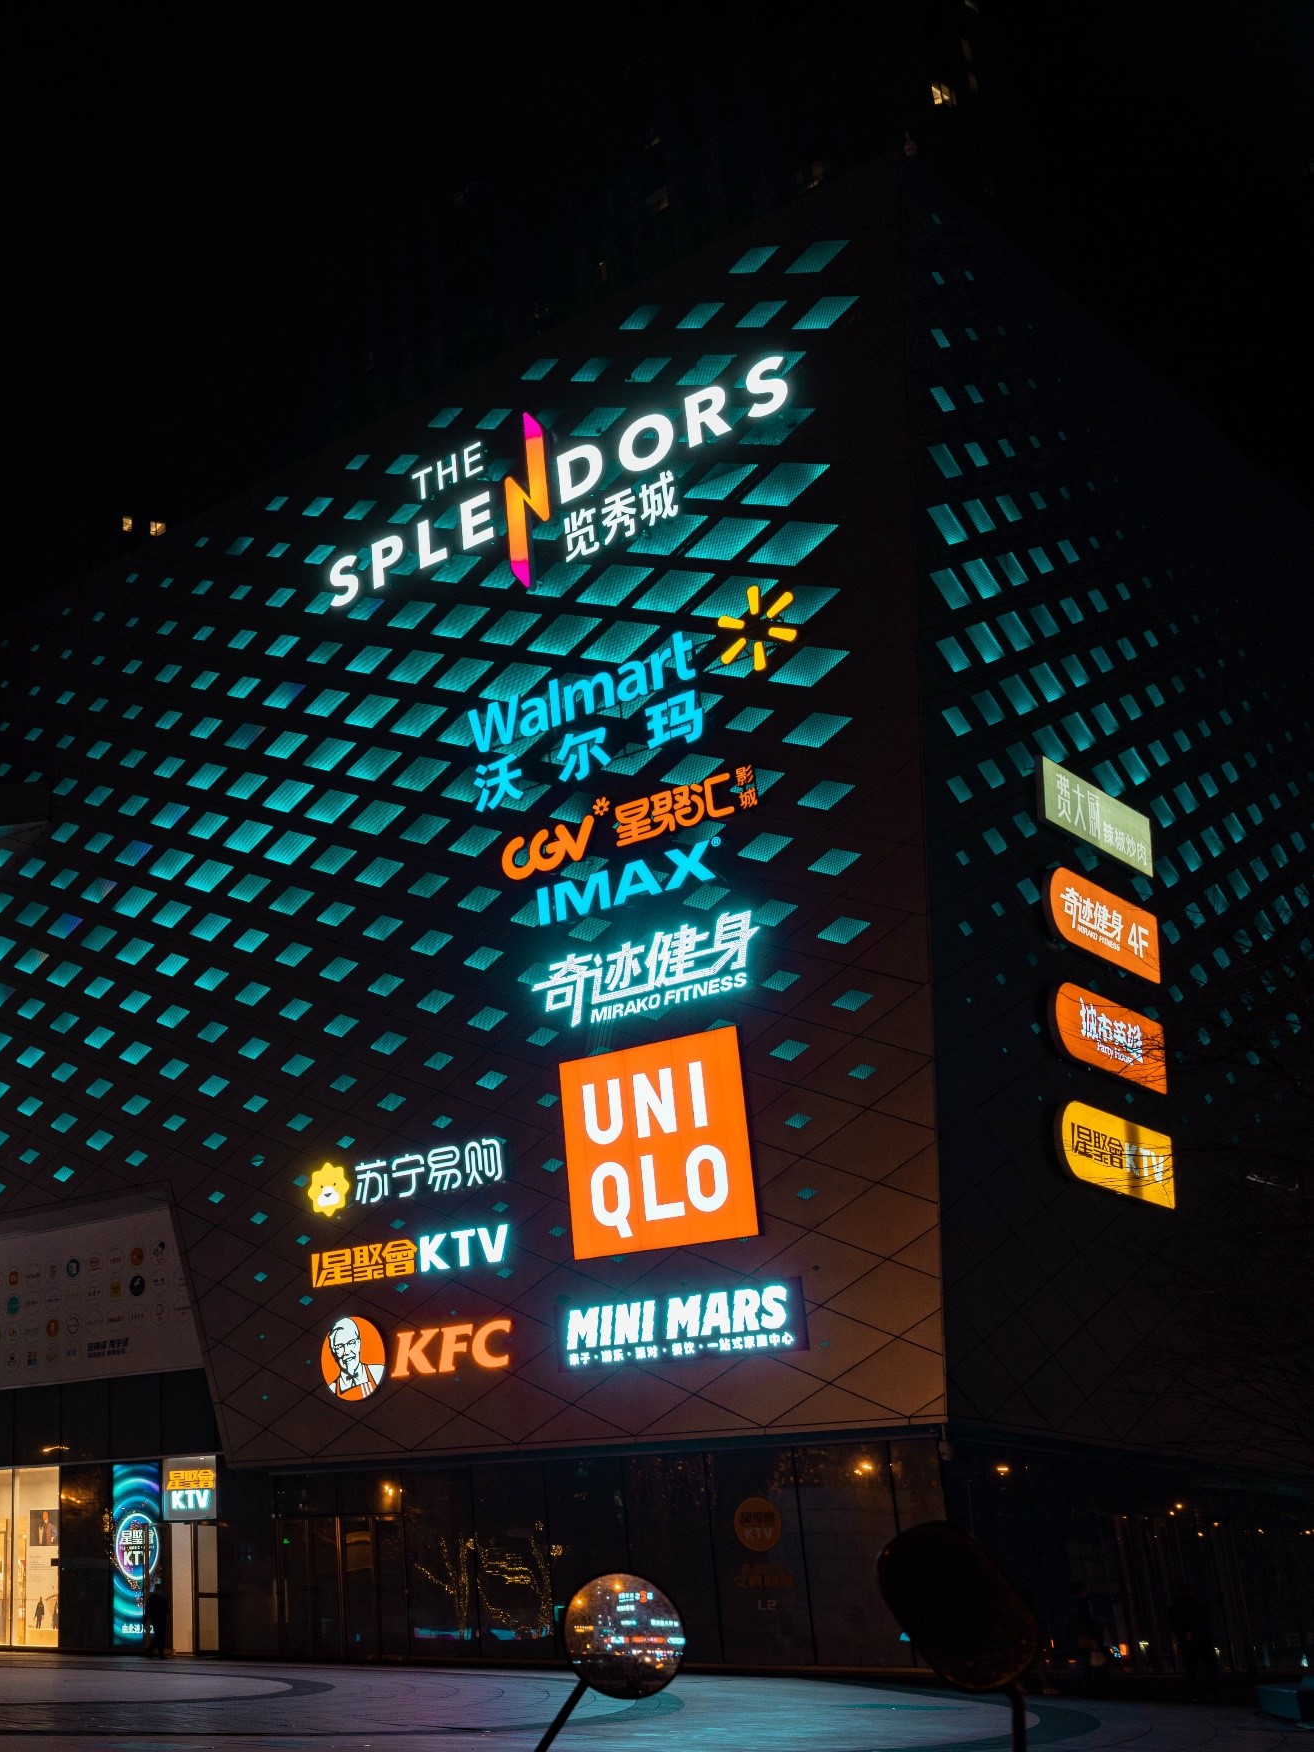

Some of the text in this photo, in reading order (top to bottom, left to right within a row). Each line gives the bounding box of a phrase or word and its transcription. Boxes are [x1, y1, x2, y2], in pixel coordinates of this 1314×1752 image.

[329, 356, 788, 607] SPLENDORS
[412, 441, 484, 499] THE
[564, 470, 679, 562] 览秀城
[467, 632, 697, 753] Walmart
[474, 690, 704, 813] 沃尔玛
[735, 764, 758, 810] 影城
[500, 772, 735, 881] CGV 星聚汇
[1060, 887, 1149, 959] 奇迹健身 4F
[531, 909, 760, 1028] 奇迹健身
[590, 972, 748, 1024] MIRAKO FITNESS
[582, 1060, 708, 1146] UNI
[355, 1138, 503, 1204] 苏宁易购
[590, 1144, 729, 1239] QLO
[1124, 1142, 1164, 1183] KTV
[419, 1224, 509, 1273] KTV
[390, 1319, 512, 1378] KFC
[567, 1285, 787, 1351] MINI MARS
[171, 1489, 210, 1509] KTV
[744, 1527, 773, 1539] KTV
[757, 1600, 776, 1610] L2
